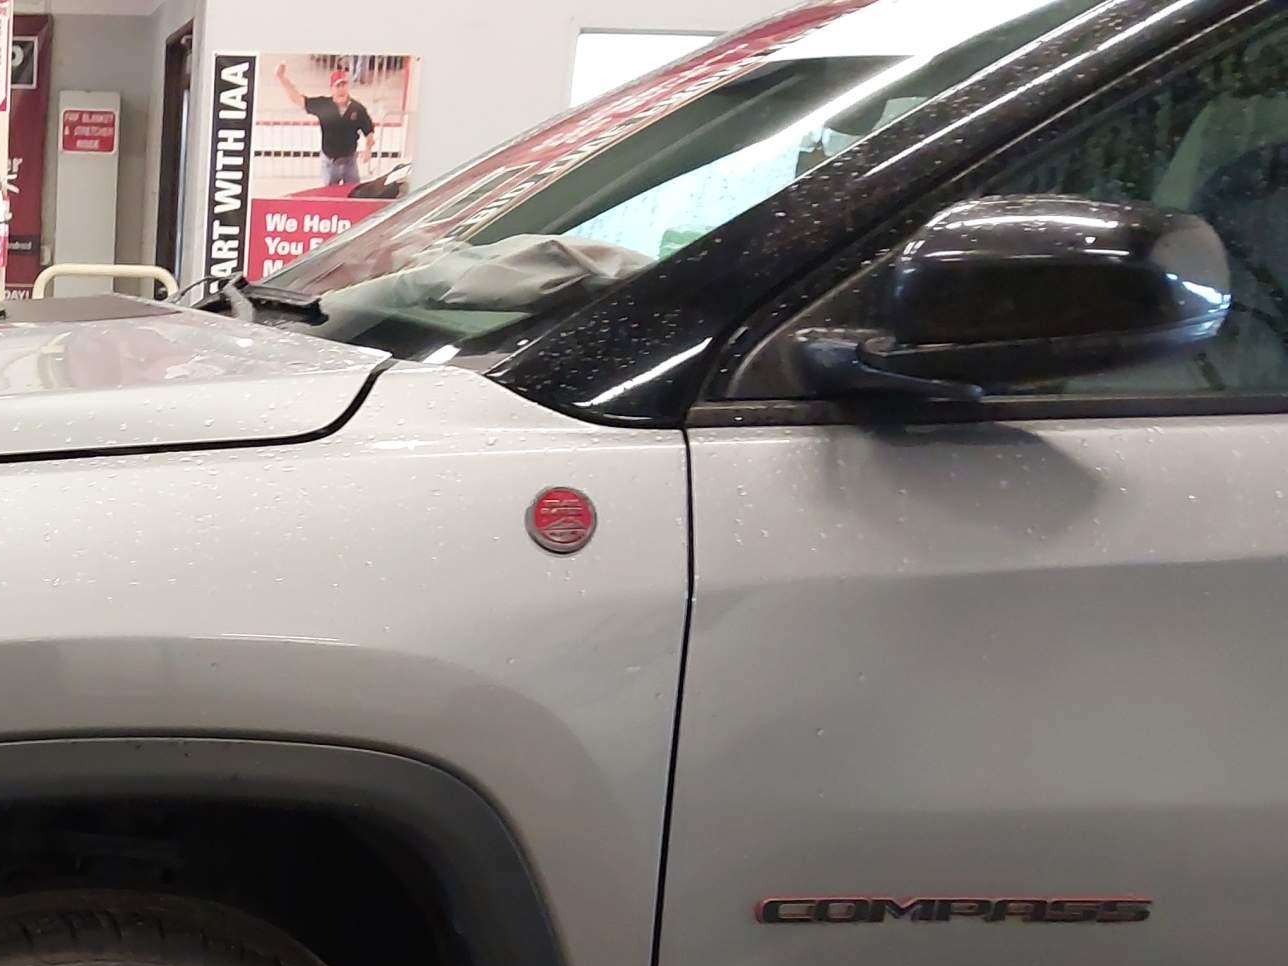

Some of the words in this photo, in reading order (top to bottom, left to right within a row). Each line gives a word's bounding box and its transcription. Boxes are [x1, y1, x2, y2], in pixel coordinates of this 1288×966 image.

[218, 61, 250, 120] IAA
[213, 129, 246, 213] WITH
[265, 213, 298, 232] We
[303, 214, 352, 234] Help
[264, 237, 304, 255] You
[756, 896, 1153, 922] COMPASS
